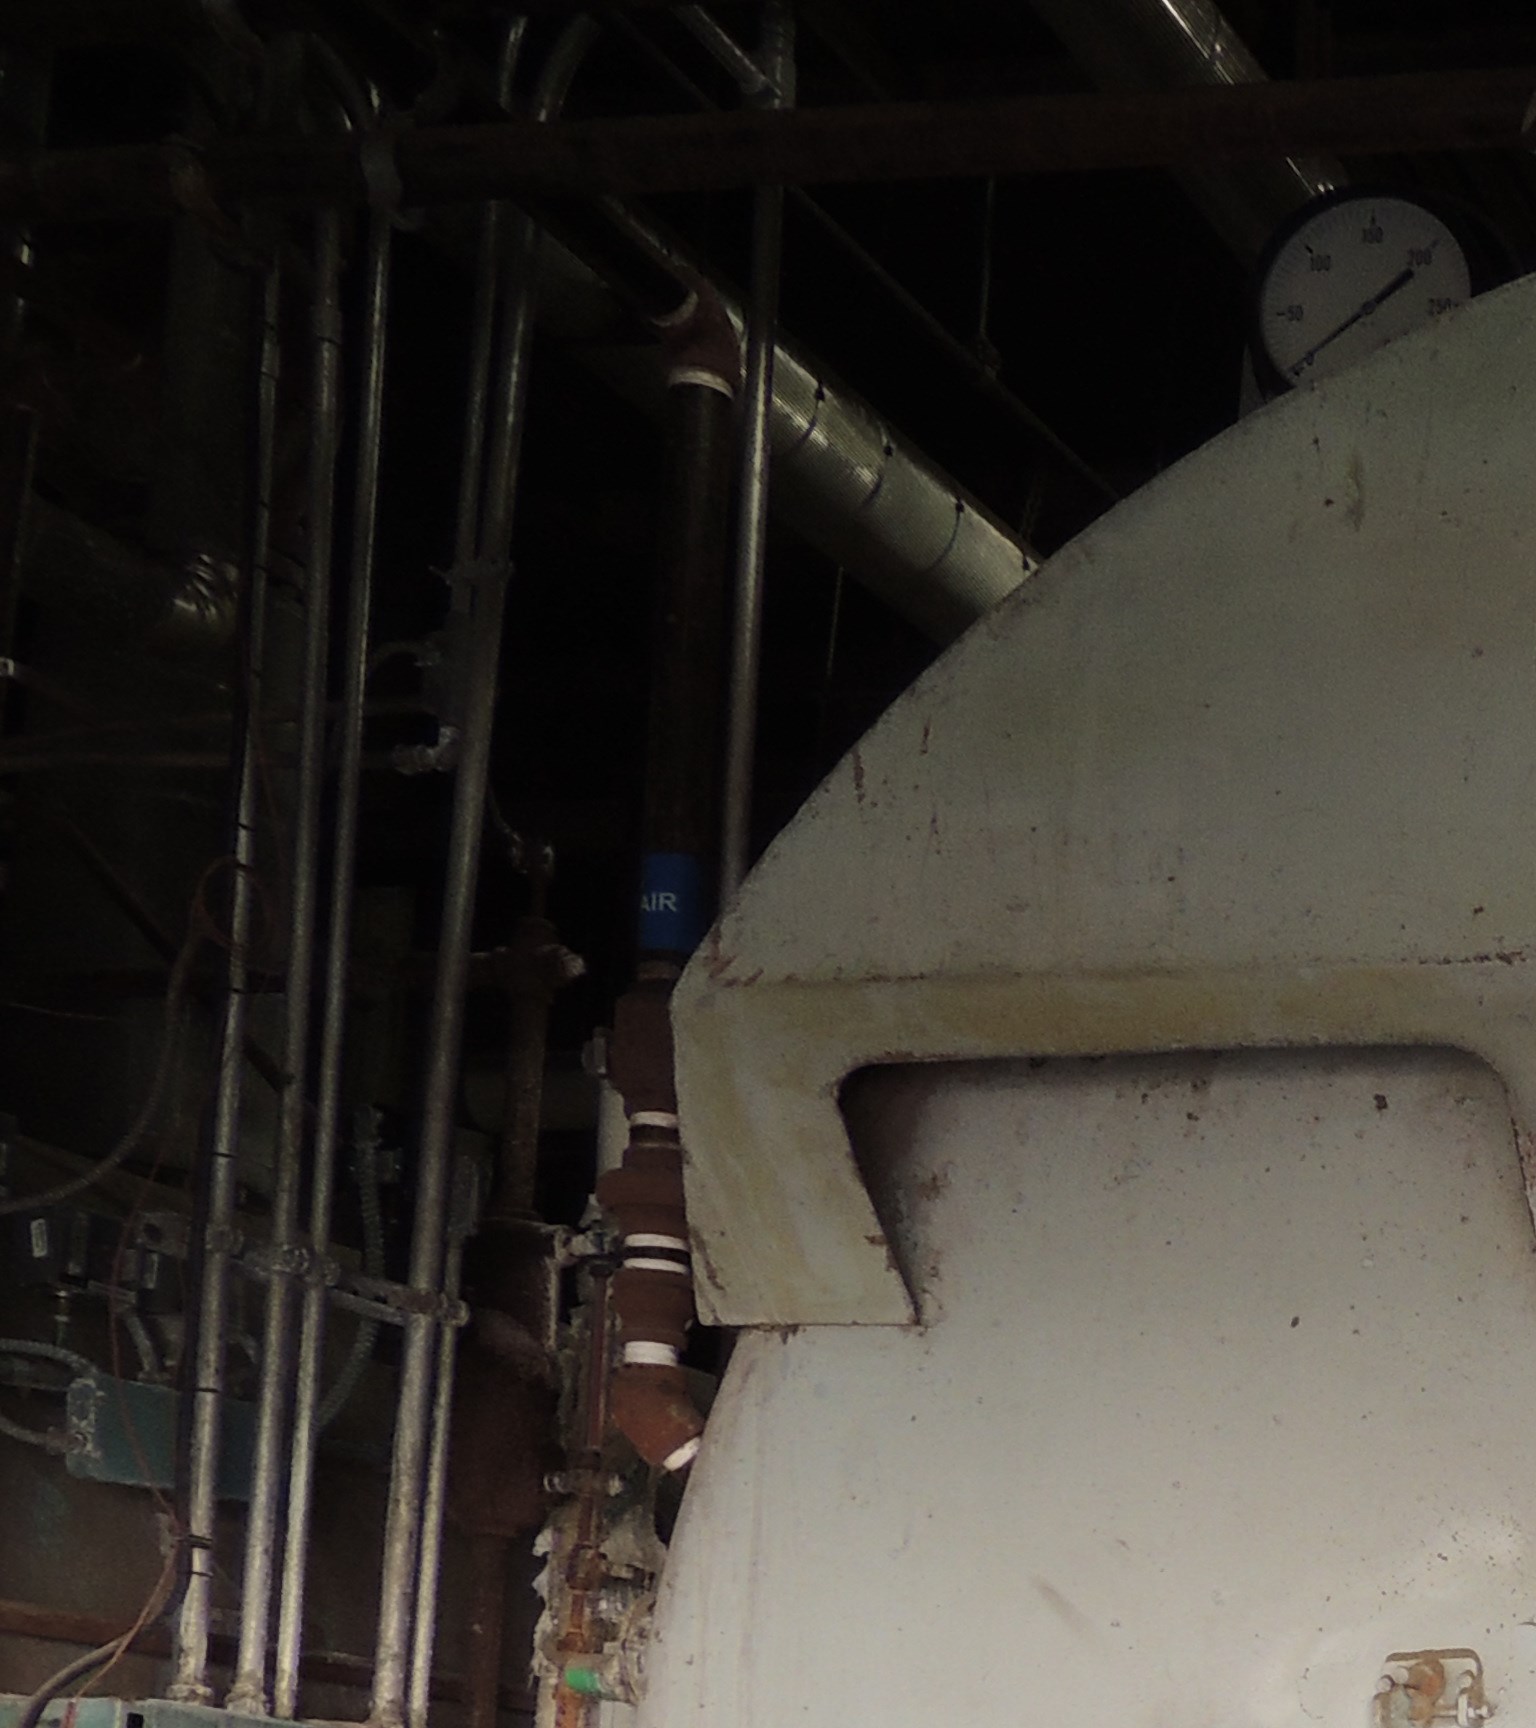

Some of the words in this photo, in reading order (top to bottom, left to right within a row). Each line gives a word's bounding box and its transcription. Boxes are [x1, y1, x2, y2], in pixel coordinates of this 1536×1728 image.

[1361, 226, 1385, 245] 150
[1310, 255, 1332, 272] 100
[1408, 248, 1433, 267] 200
[1286, 305, 1304, 322] 50
[640, 891, 678, 913] AIR
